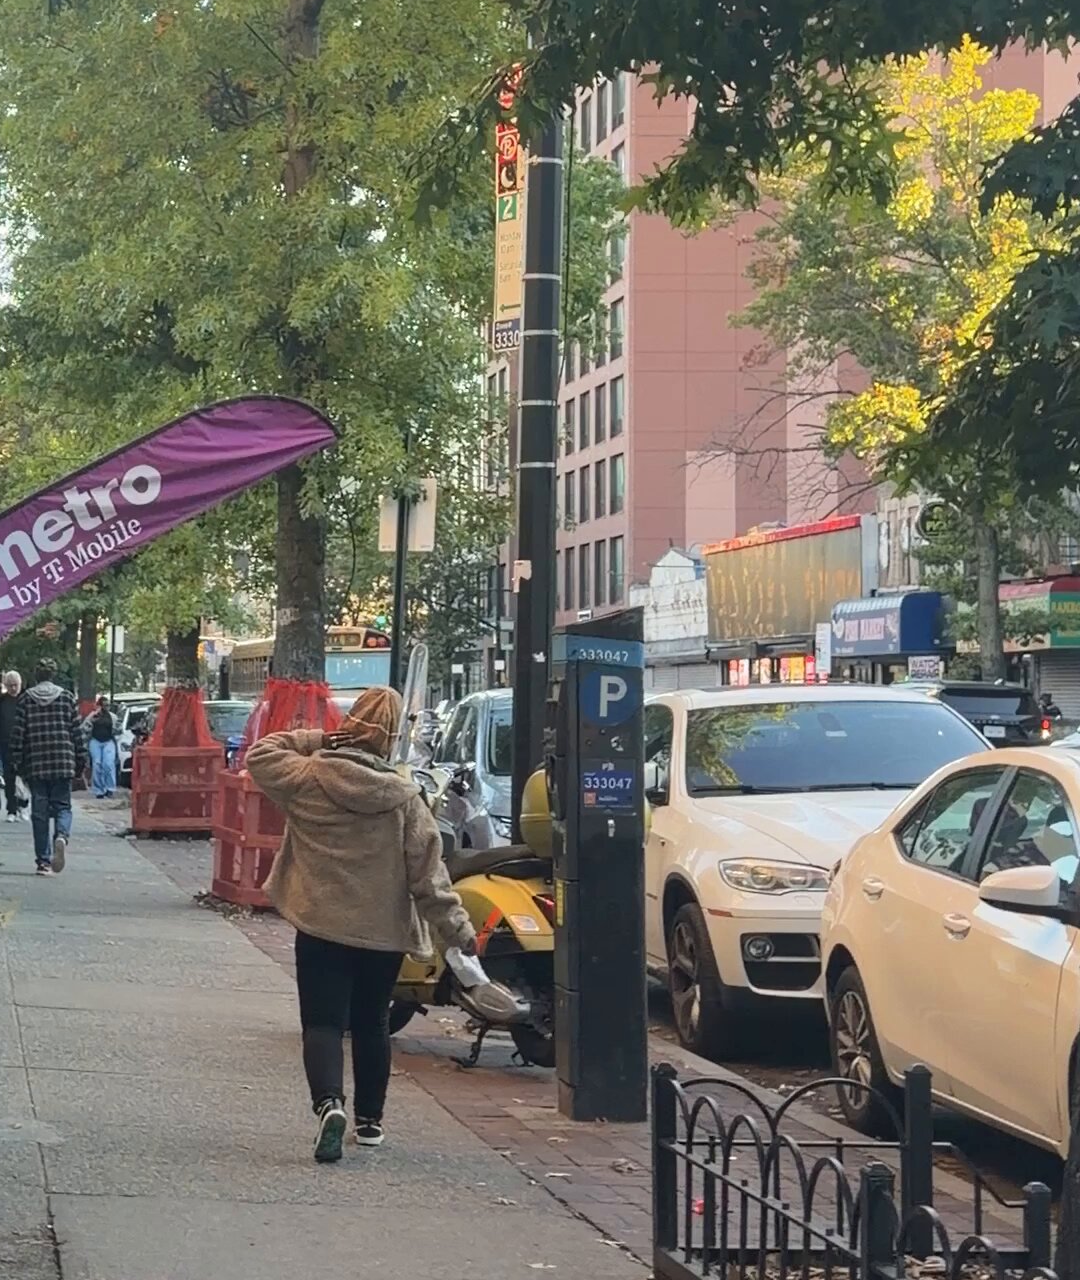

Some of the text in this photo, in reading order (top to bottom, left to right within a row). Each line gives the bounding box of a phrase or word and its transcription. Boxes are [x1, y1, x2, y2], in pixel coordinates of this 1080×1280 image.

[502, 195, 513, 220] 2
[12, 578, 43, 607] by
[578, 649, 629, 663] 333047
[599, 675, 628, 717] P
[584, 777, 633, 789] 333047
